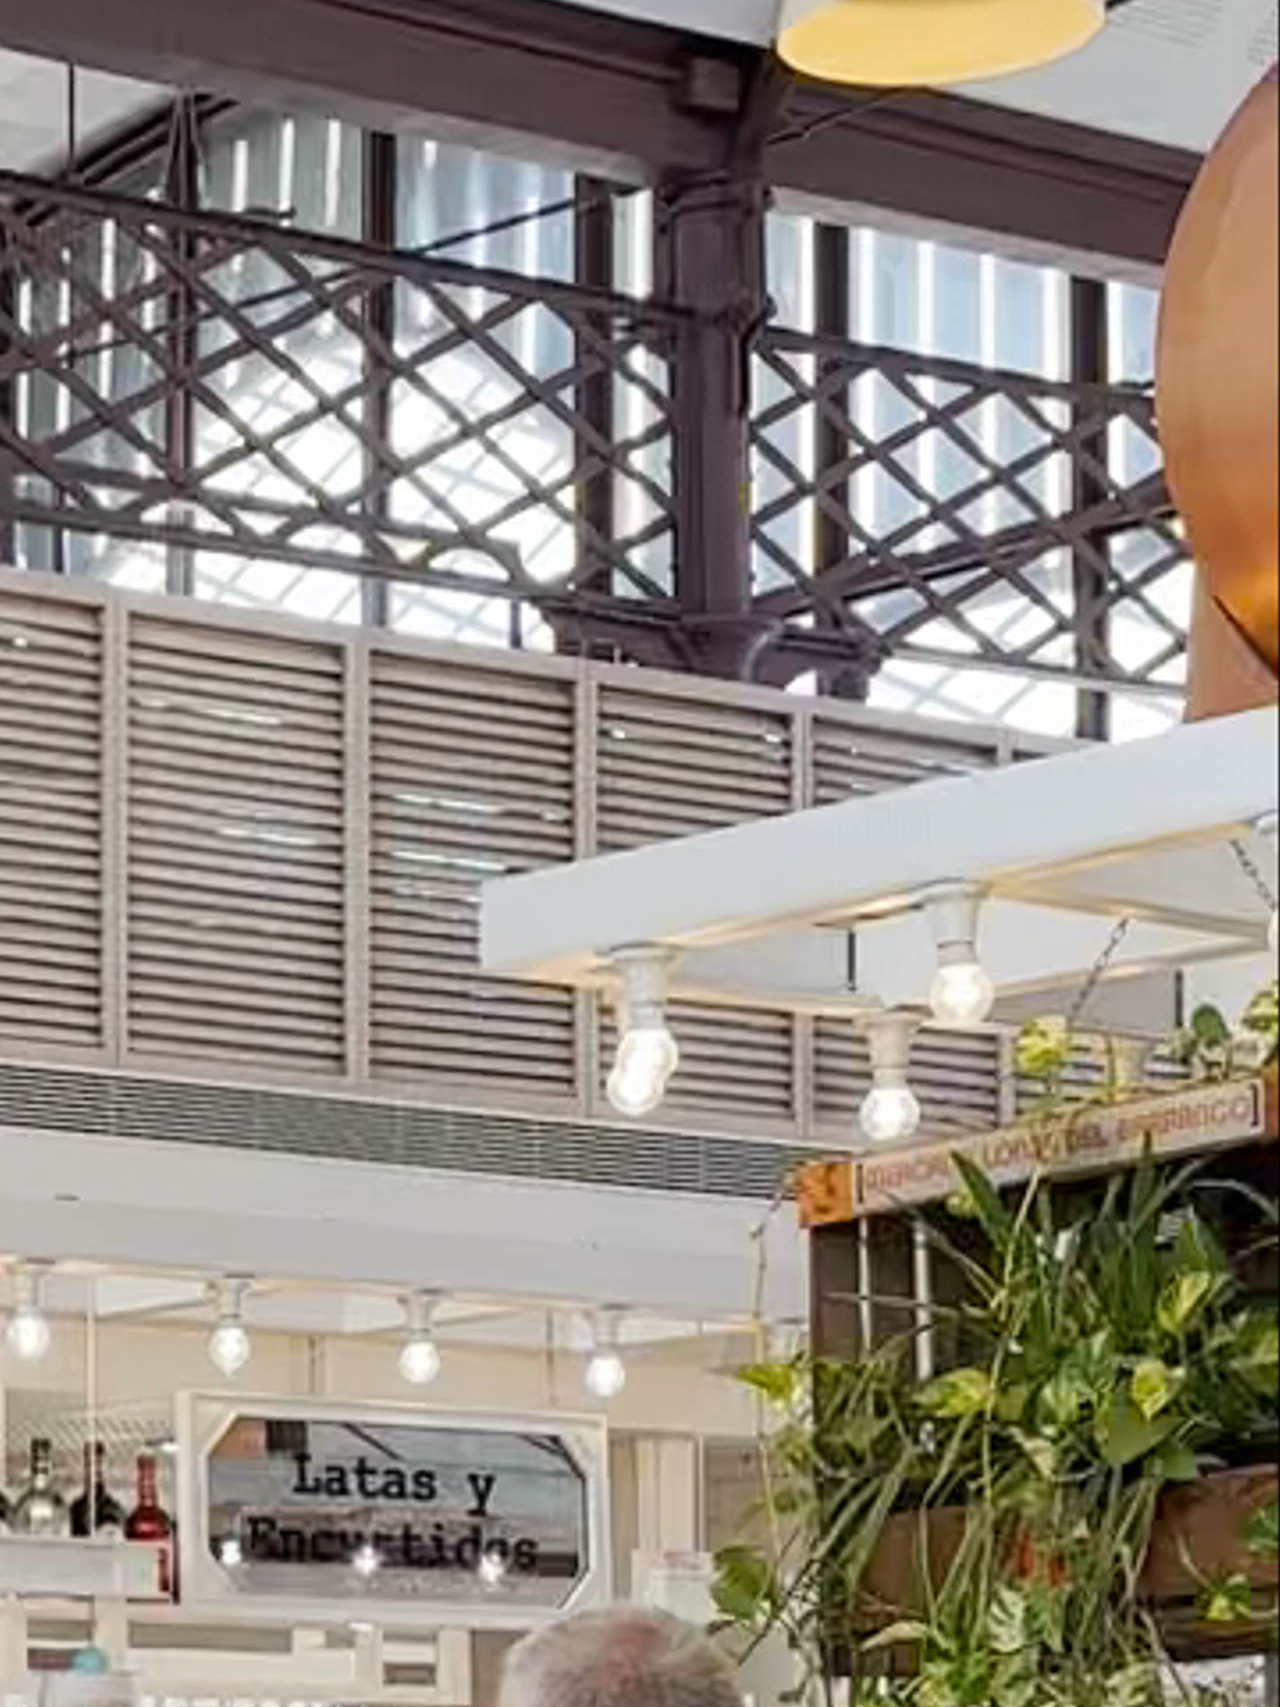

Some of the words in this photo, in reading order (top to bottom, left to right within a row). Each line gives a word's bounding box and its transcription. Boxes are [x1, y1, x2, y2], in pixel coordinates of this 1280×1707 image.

[292, 1451, 438, 1502] Latas
[466, 1472, 497, 1518] y
[246, 1515, 540, 1571] Encurtidos
